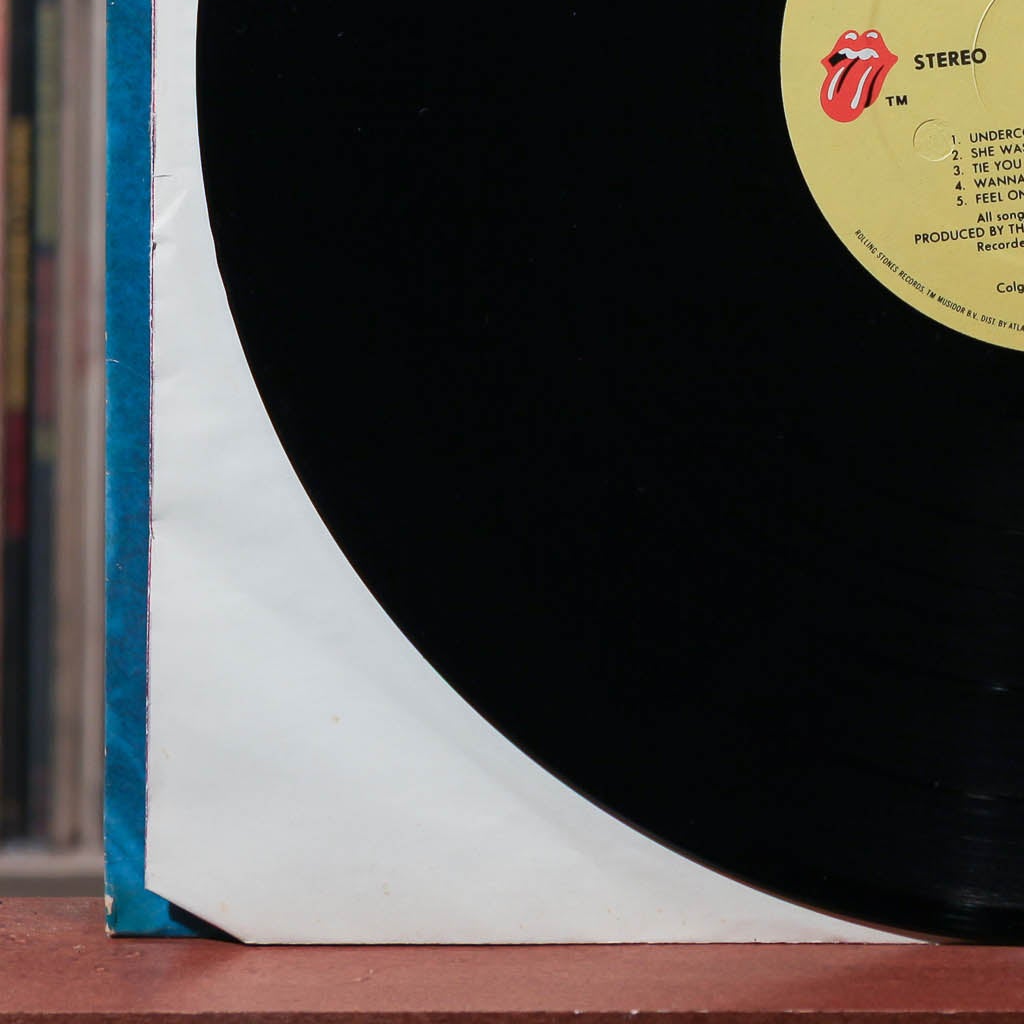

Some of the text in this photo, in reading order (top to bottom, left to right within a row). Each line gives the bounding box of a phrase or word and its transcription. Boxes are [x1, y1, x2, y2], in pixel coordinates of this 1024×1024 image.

[914, 48, 987, 70] STEREO
[886, 95, 908, 106] TM
[952, 134, 961, 145] 1.
[952, 150, 962, 161] 2.
[971, 146, 995, 159] SHE
[953, 166, 964, 176] 3.
[972, 161, 990, 174] TIE
[994, 158, 1022, 171] YOU
[955, 180, 966, 191] 4.
[956, 196, 968, 207] 5.
[975, 192, 1004, 204] FEEL
[977, 211, 992, 224] All
[914, 228, 985, 245] PRODUCED
[990, 225, 1004, 236] BY
[854, 229, 878, 254] ROLLING
[876, 252, 899, 273] STONES
[926, 289, 936, 299] TM
[937, 295, 966, 315] MUSIDOR
[998, 320, 1007, 328] BY
